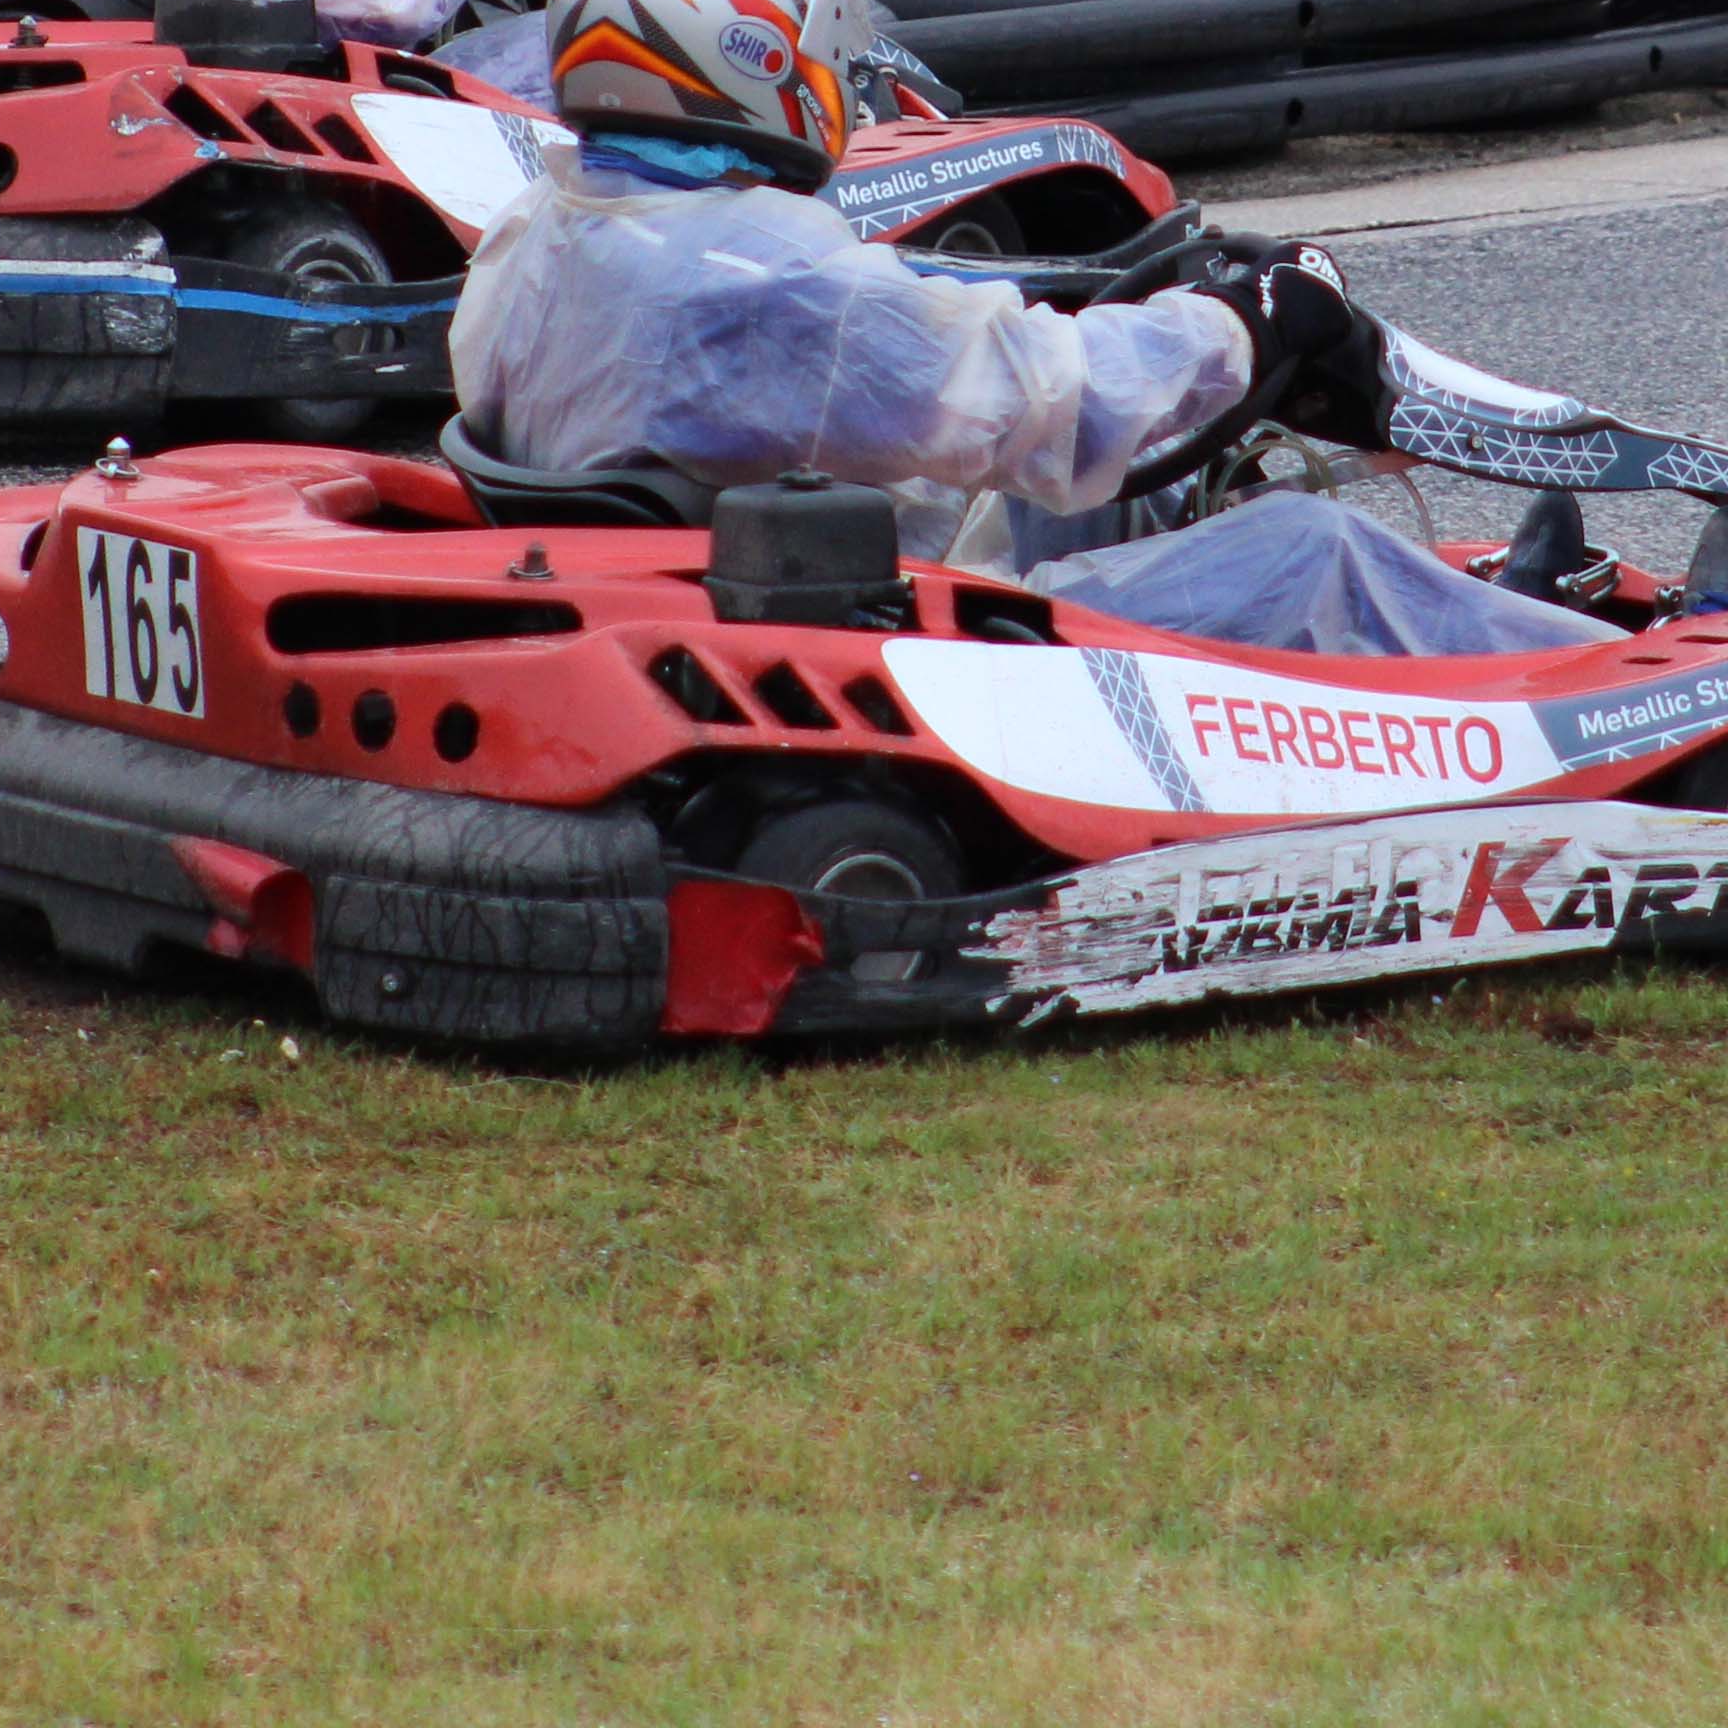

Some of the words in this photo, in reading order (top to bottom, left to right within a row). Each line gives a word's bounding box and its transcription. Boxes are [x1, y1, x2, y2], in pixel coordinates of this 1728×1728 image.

[837, 168, 929, 209] Metallic
[931, 139, 1044, 185] Structures
[86, 531, 201, 715] 165
[1184, 692, 1504, 785] FERBERTO
[1577, 689, 1692, 741] Metallic
